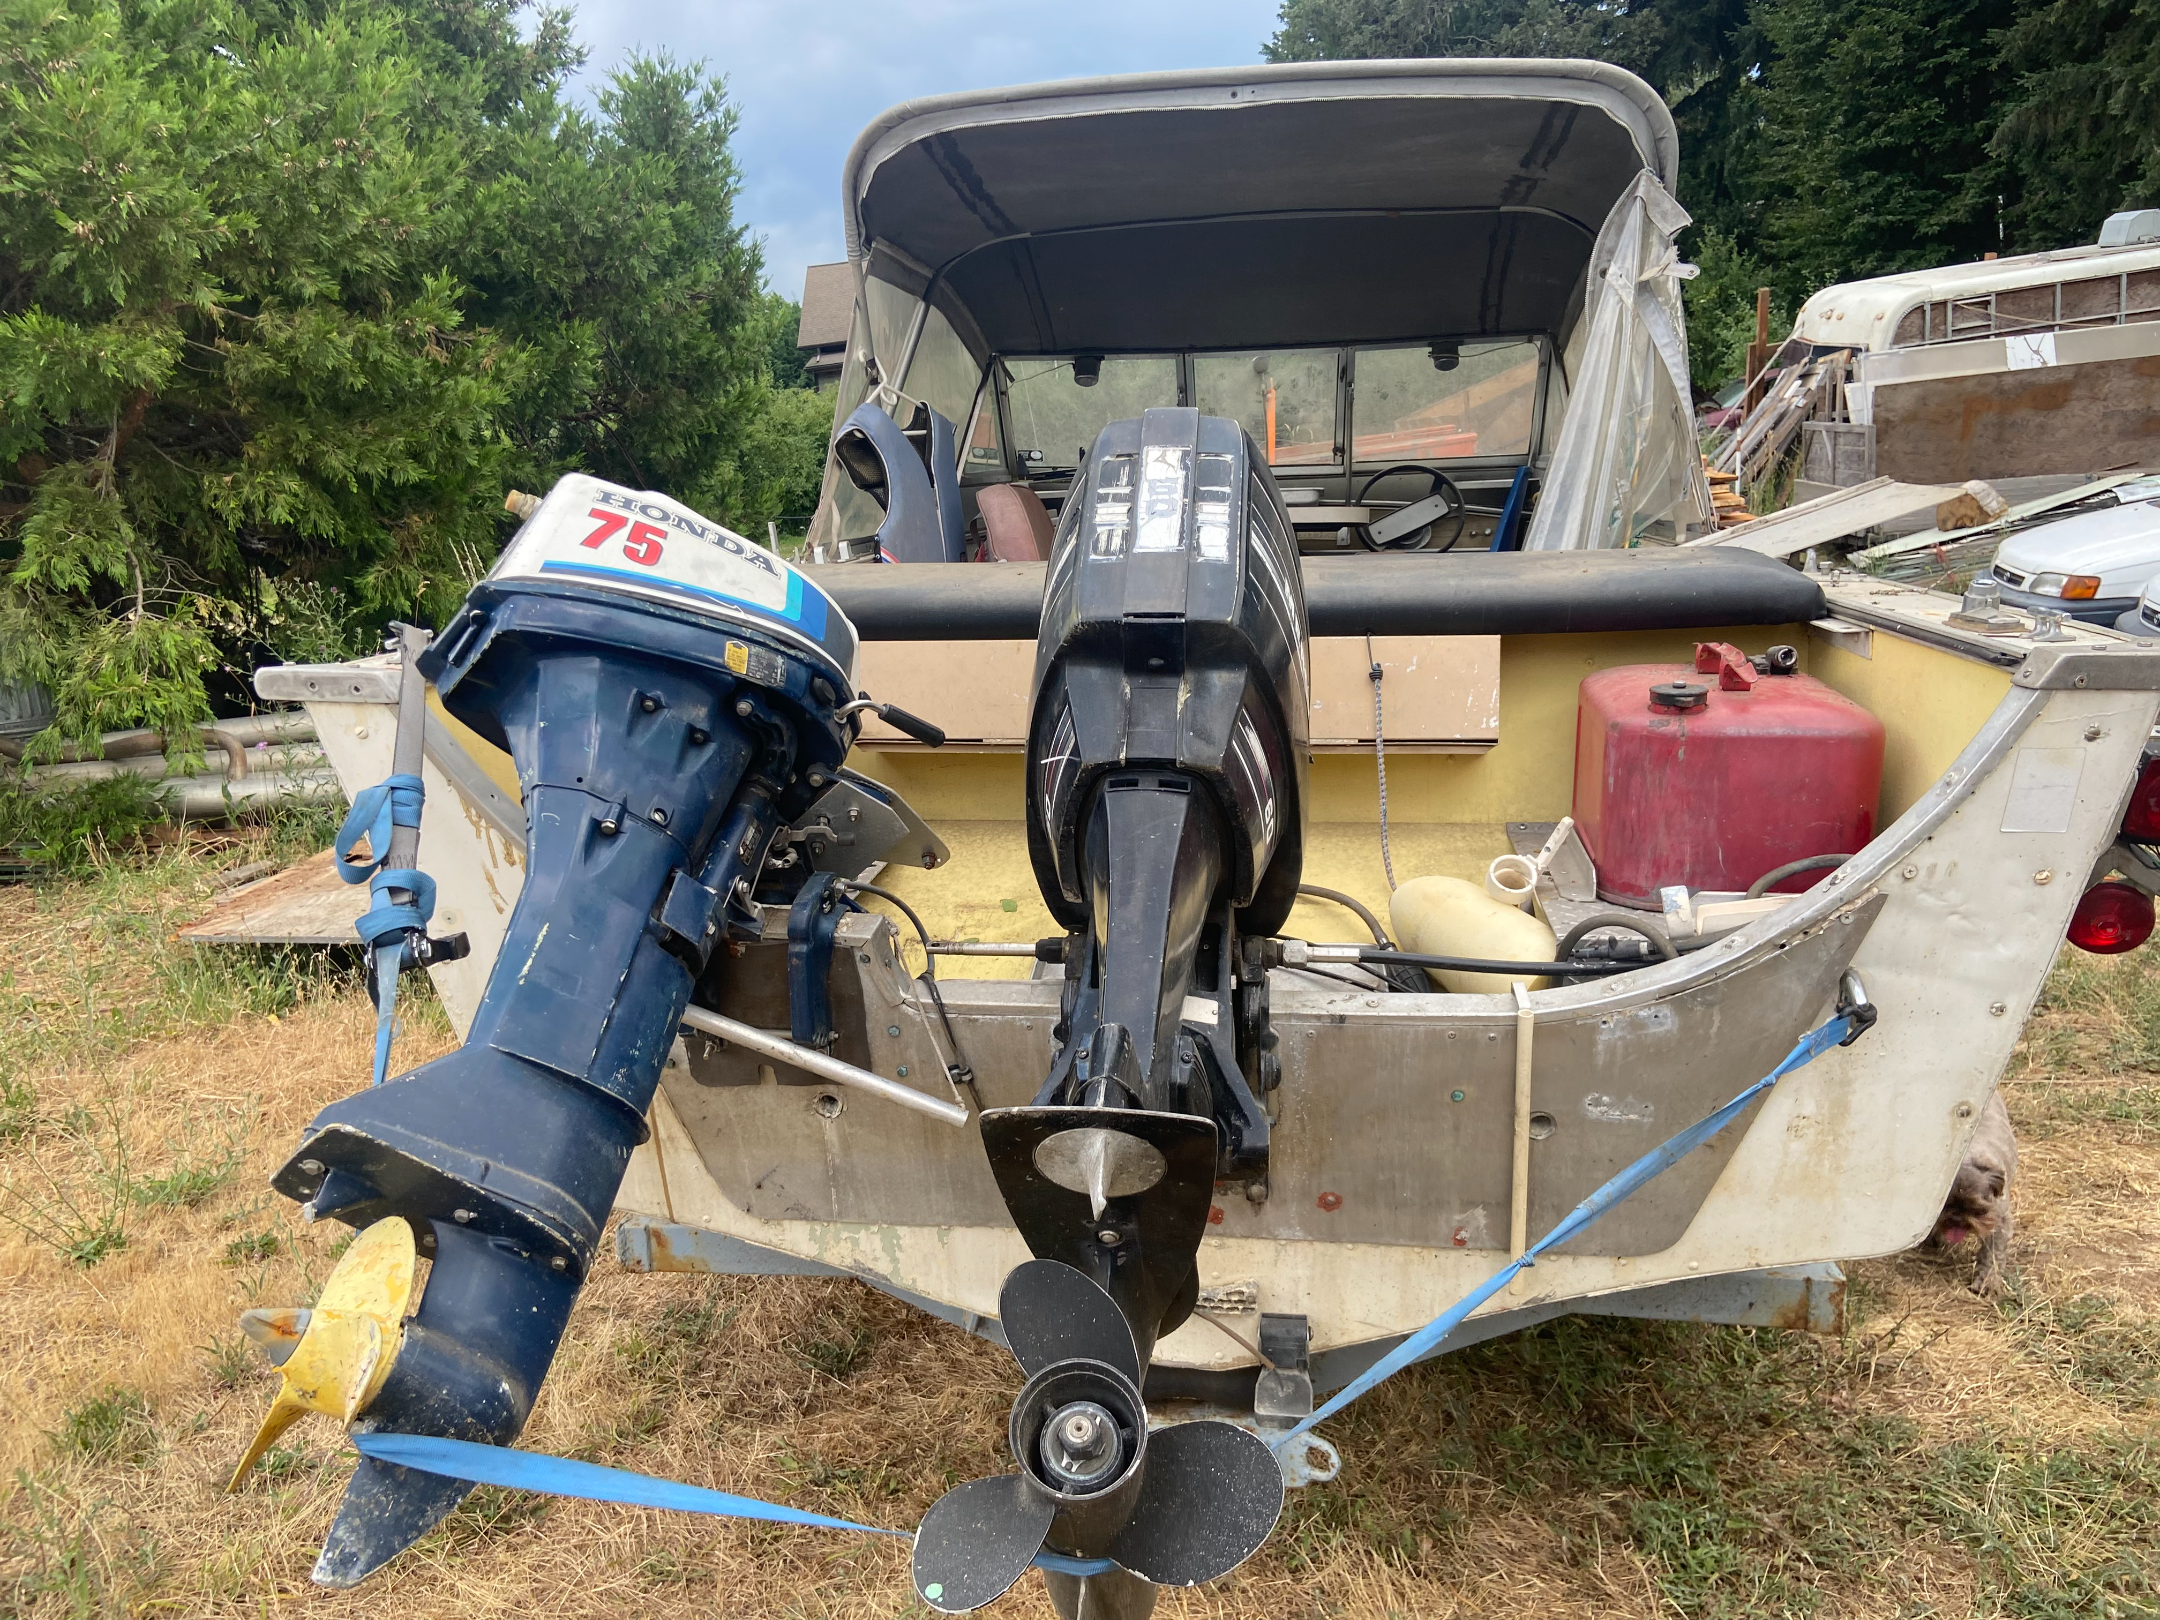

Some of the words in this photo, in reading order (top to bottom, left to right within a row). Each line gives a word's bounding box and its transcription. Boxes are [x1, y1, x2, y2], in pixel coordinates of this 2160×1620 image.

[579, 508, 669, 567] 75
[593, 488, 782, 579] HONDA
[1264, 797, 1274, 845] 60
